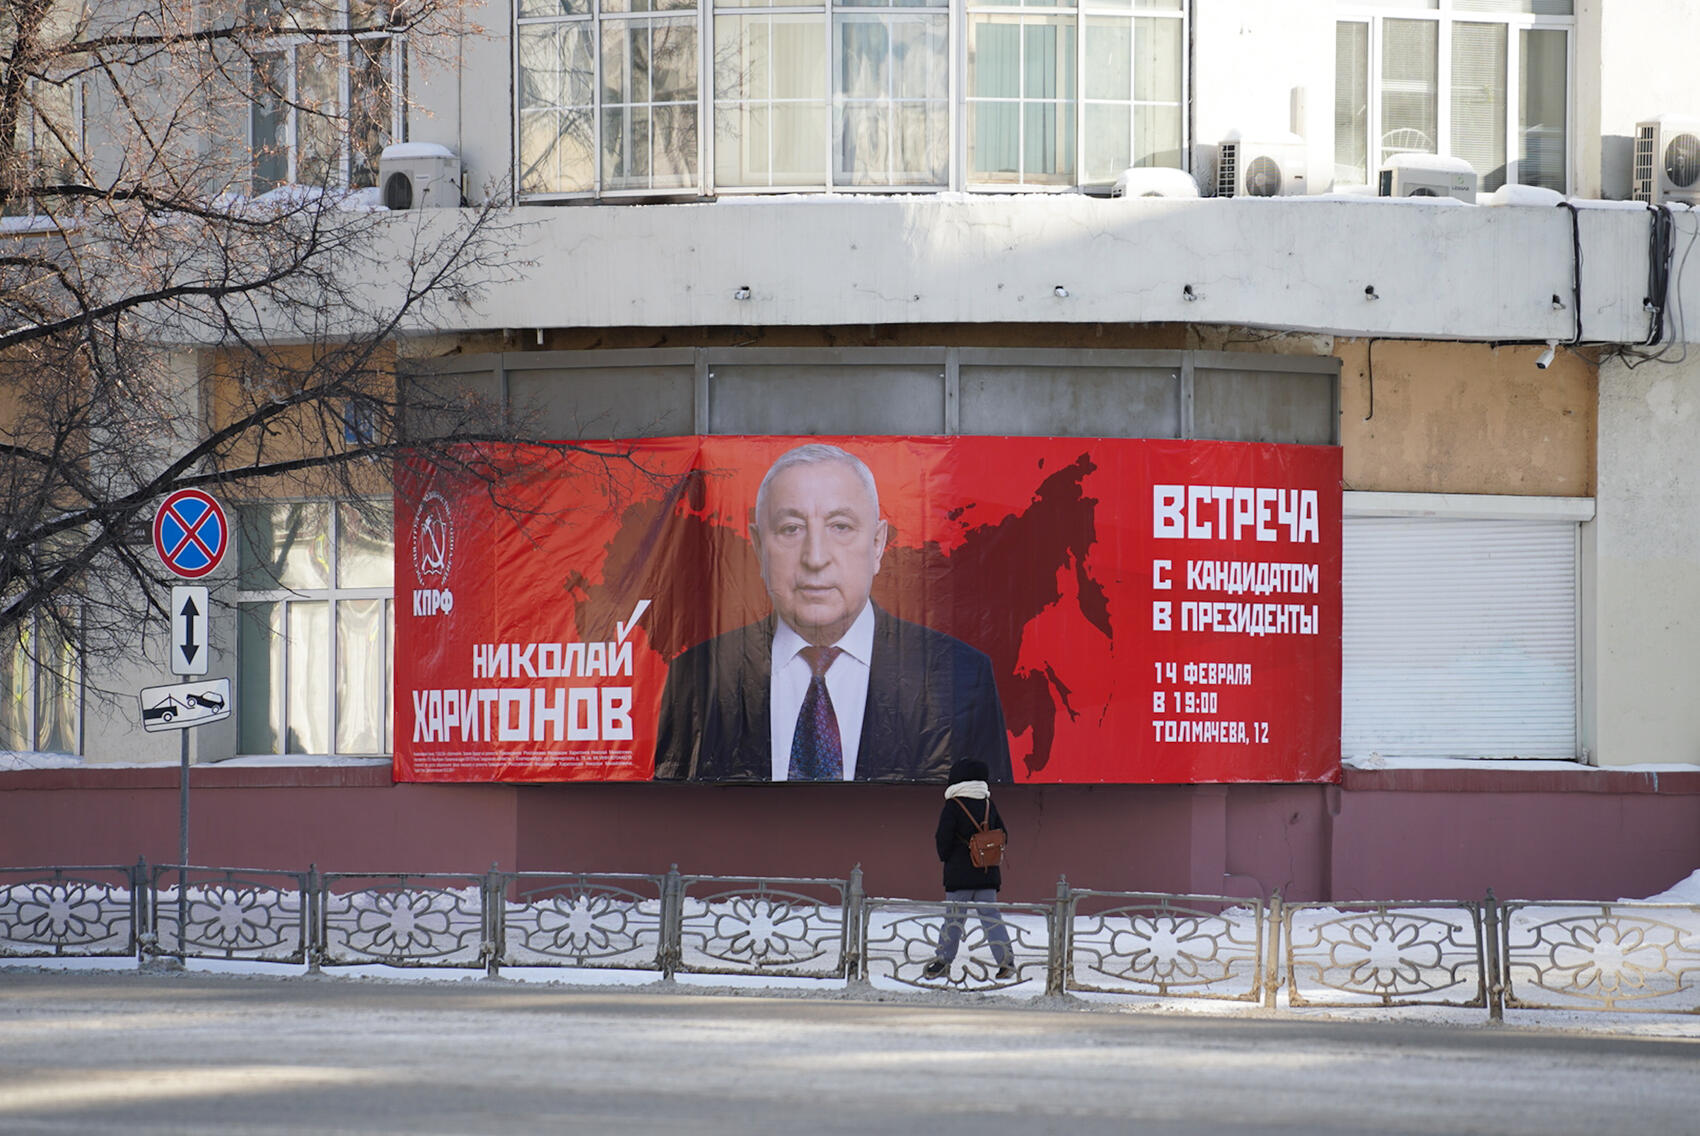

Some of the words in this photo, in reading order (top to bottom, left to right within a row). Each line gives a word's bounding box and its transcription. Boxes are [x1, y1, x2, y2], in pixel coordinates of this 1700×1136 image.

[1153, 484, 1319, 543] ВСТРЕЧА
[1153, 559, 1172, 590] С
[1187, 560, 1319, 596] КАНДИДАТОМ
[413, 589, 453, 617] КПРФ
[1153, 601, 1172, 631] В
[1181, 601, 1319, 637] ПРЕЗИДЕНТЫ
[1155, 662, 1177, 684] 14
[1183, 662, 1252, 685] ФЕВРАЛЯ
[412, 686, 633, 743] ХАРИТОНОВ
[1153, 691, 1166, 713] В
[1174, 691, 1218, 713] 19:00
[1153, 720, 1250, 745] ТОЛМАЧЕВА,
[1254, 722, 1270, 744] 12
